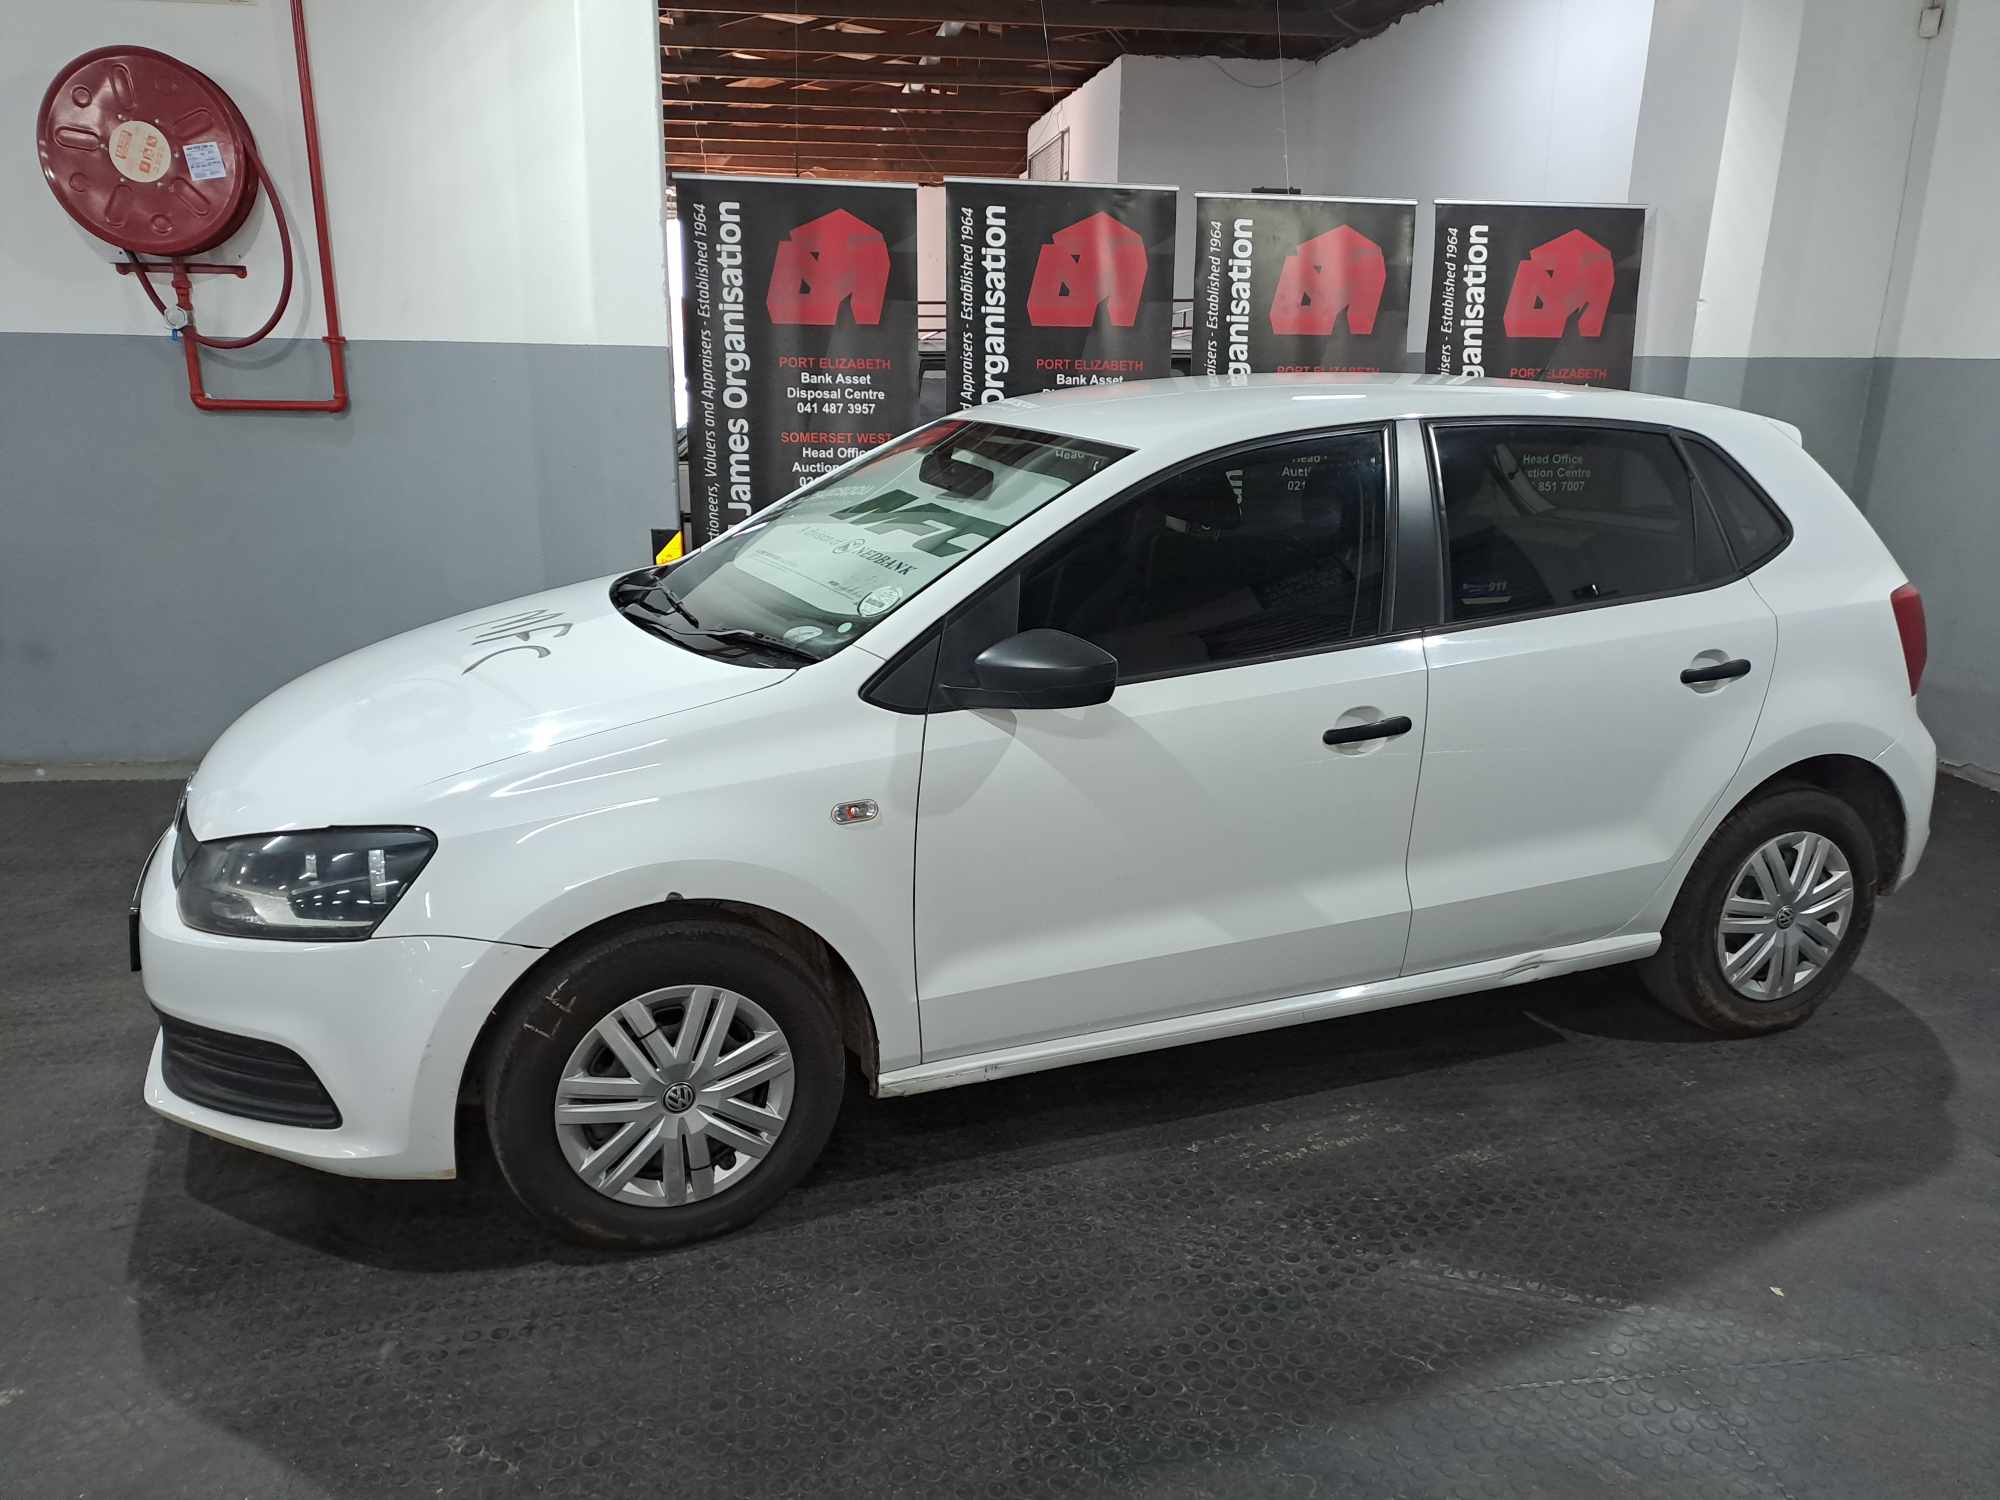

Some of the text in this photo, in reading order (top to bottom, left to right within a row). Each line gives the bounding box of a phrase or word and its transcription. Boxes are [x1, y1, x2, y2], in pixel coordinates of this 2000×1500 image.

[692, 202, 708, 237] 1964
[960, 207, 974, 240] 1964
[1208, 221, 1222, 253] 1964
[1446, 227, 1459, 259] 1964
[693, 240, 711, 318] Established
[960, 244, 974, 320] Established
[1206, 256, 1221, 329] Established
[716, 201, 751, 409] Organisation
[981, 205, 1009, 405] Organisation
[1226, 218, 1254, 376] ganisation
[1440, 262, 1457, 334] Established
[1460, 224, 1489, 378] ganisation
[698, 329, 717, 399] Appraisers
[779, 356, 892, 370] PORT ELIZABETH
[960, 331, 976, 400] Appraisers
[1036, 359, 1144, 371] PORT ELIZABETH
[1204, 340, 1217, 376] aisers
[1437, 344, 1452, 376] isers
[1510, 367, 1542, 378] PORT
[786, 387, 885, 401] Disposal Centre
[800, 372, 872, 385] Bank Asset
[1056, 373, 1124, 385] Bank Asset
[700, 401, 716, 427] and
[796, 402, 876, 415] 041 487 3957
[703, 430, 718, 478] Valuers
[780, 432, 852, 444] SOMERSET
[802, 447, 866, 459] Head Offic
[727, 418, 752, 516] James
[1281, 466, 1312, 477] Auct
[1522, 453, 1584, 465] Head Office
[1527, 467, 1592, 479] ction Centre
[1537, 480, 1585, 492] 851 7007
[705, 482, 721, 541] tioneers,
[855, 546, 918, 576] NEDBANK
